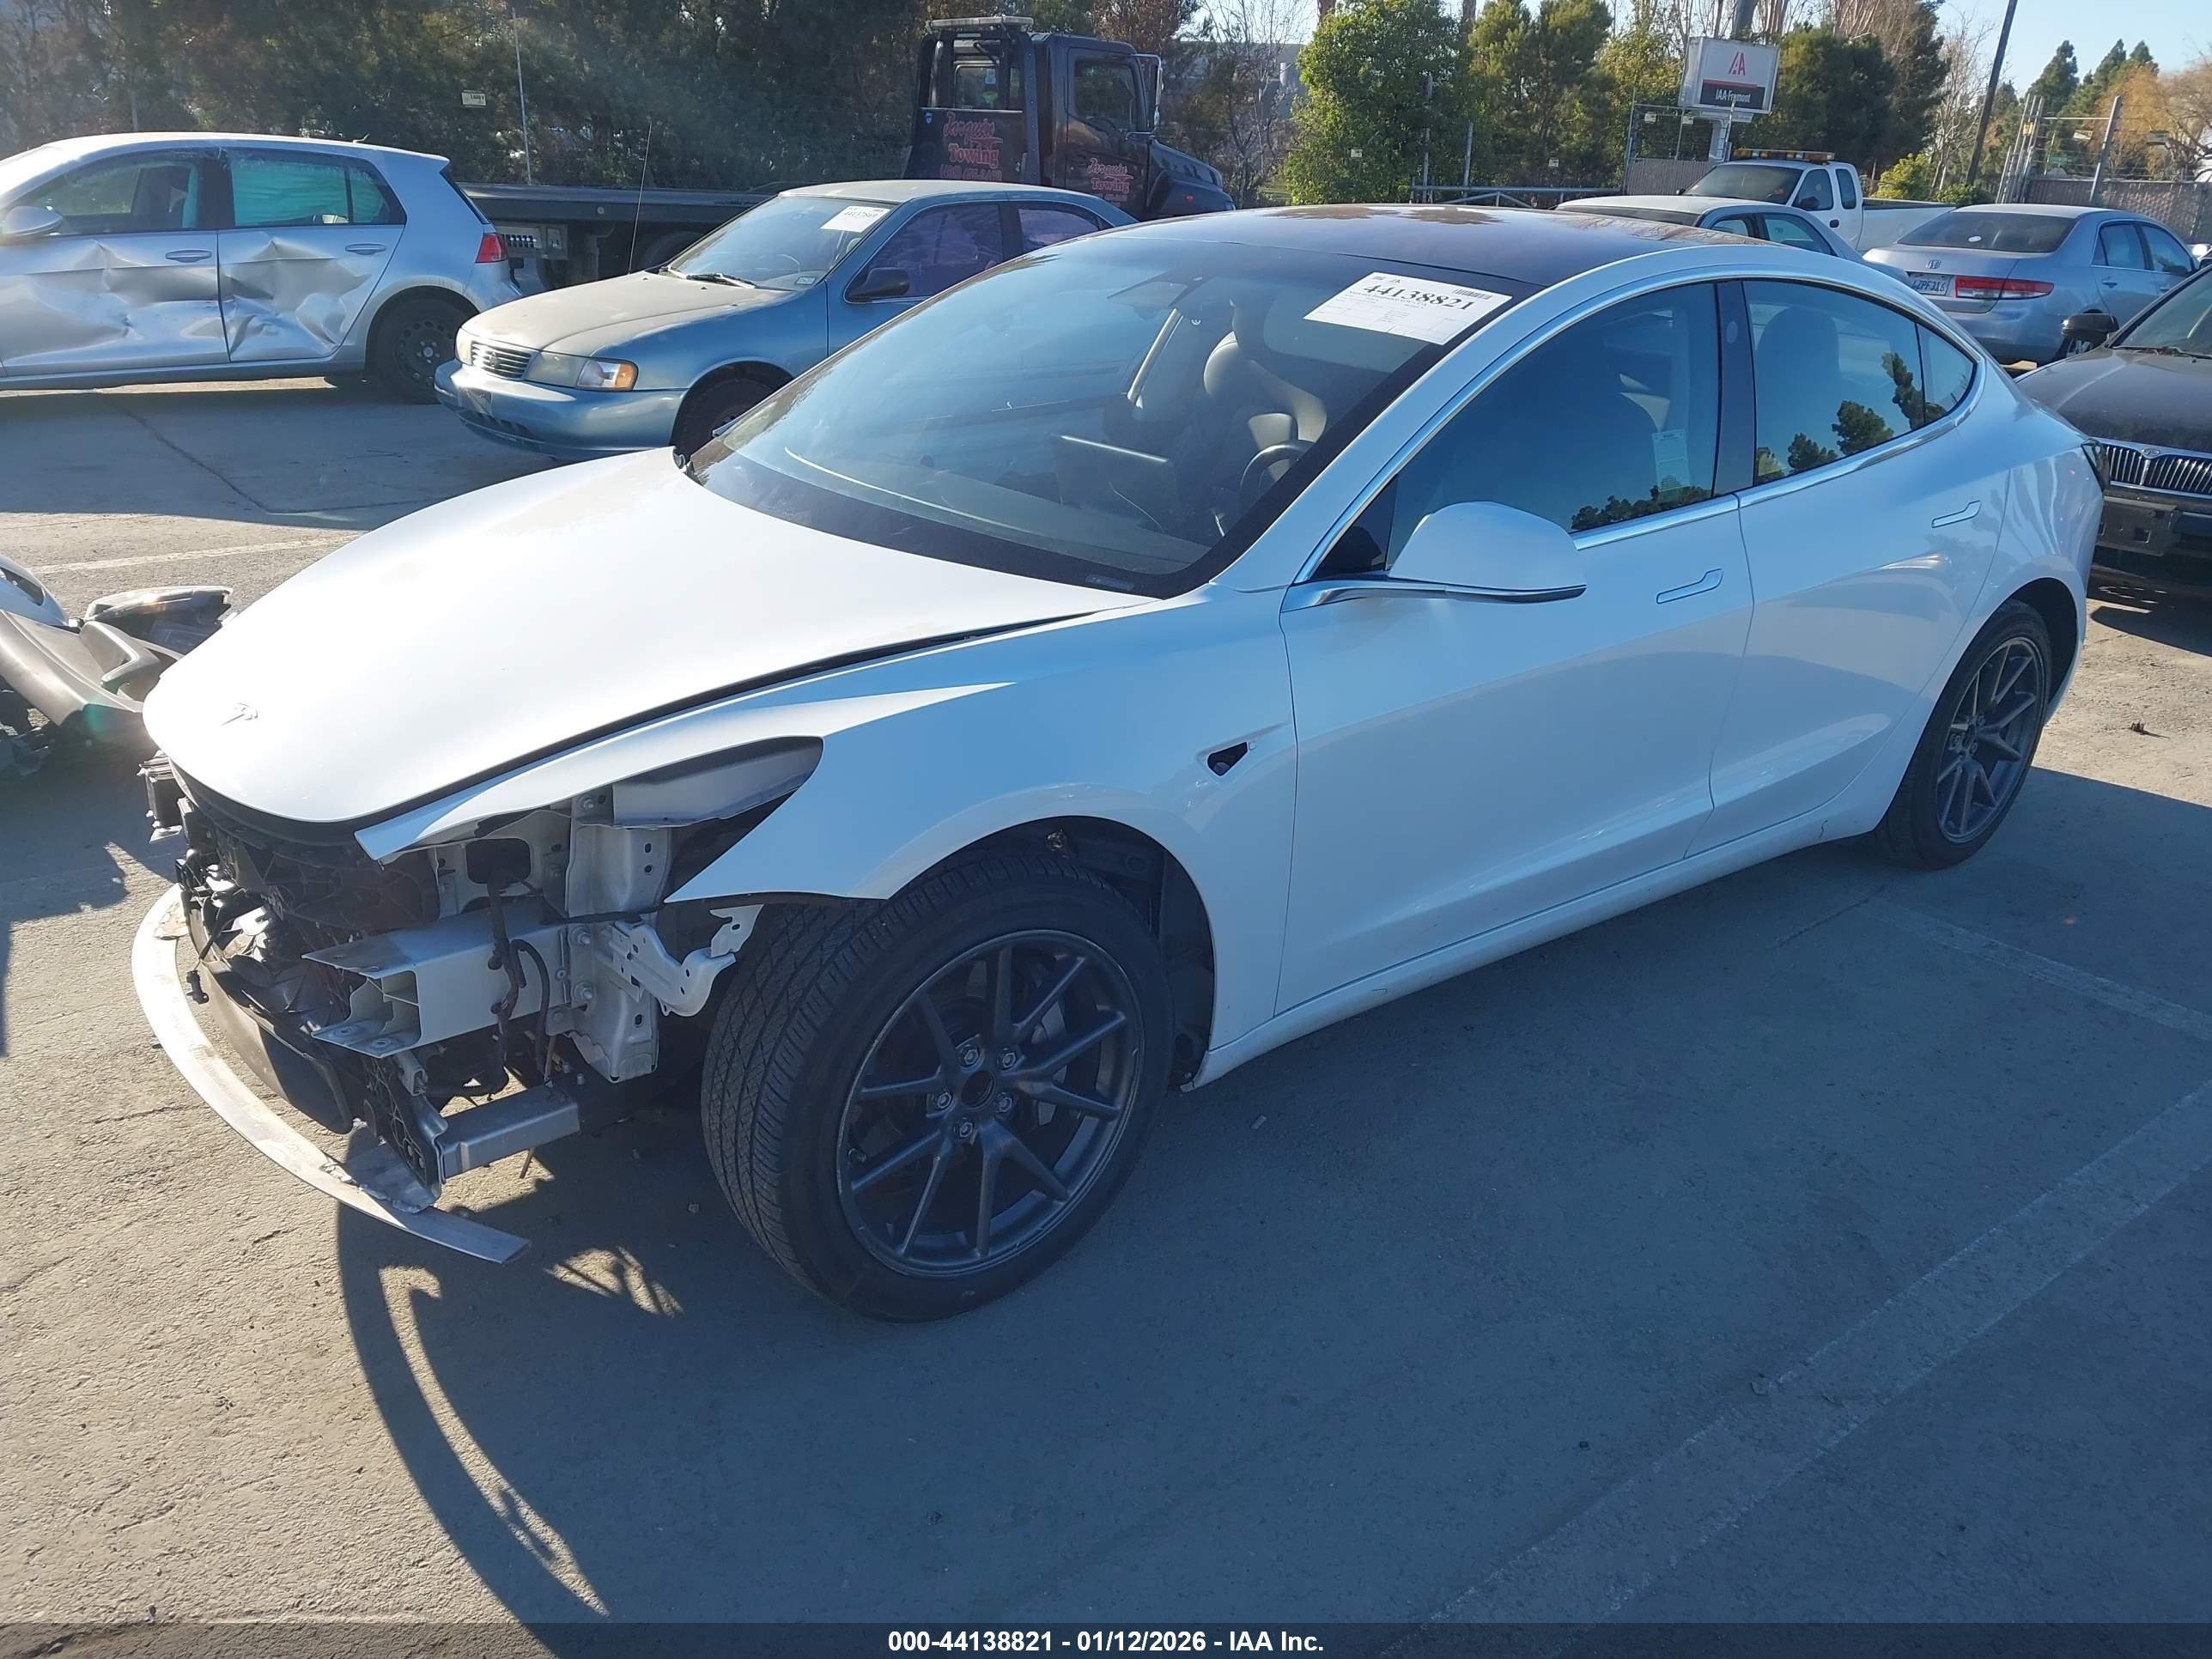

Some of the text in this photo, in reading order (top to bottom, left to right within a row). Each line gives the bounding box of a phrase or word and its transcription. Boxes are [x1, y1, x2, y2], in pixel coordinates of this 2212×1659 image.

[948, 143, 999, 169] Towing
[1091, 178, 1130, 194] Towing
[1364, 284, 1475, 310] 44138821
